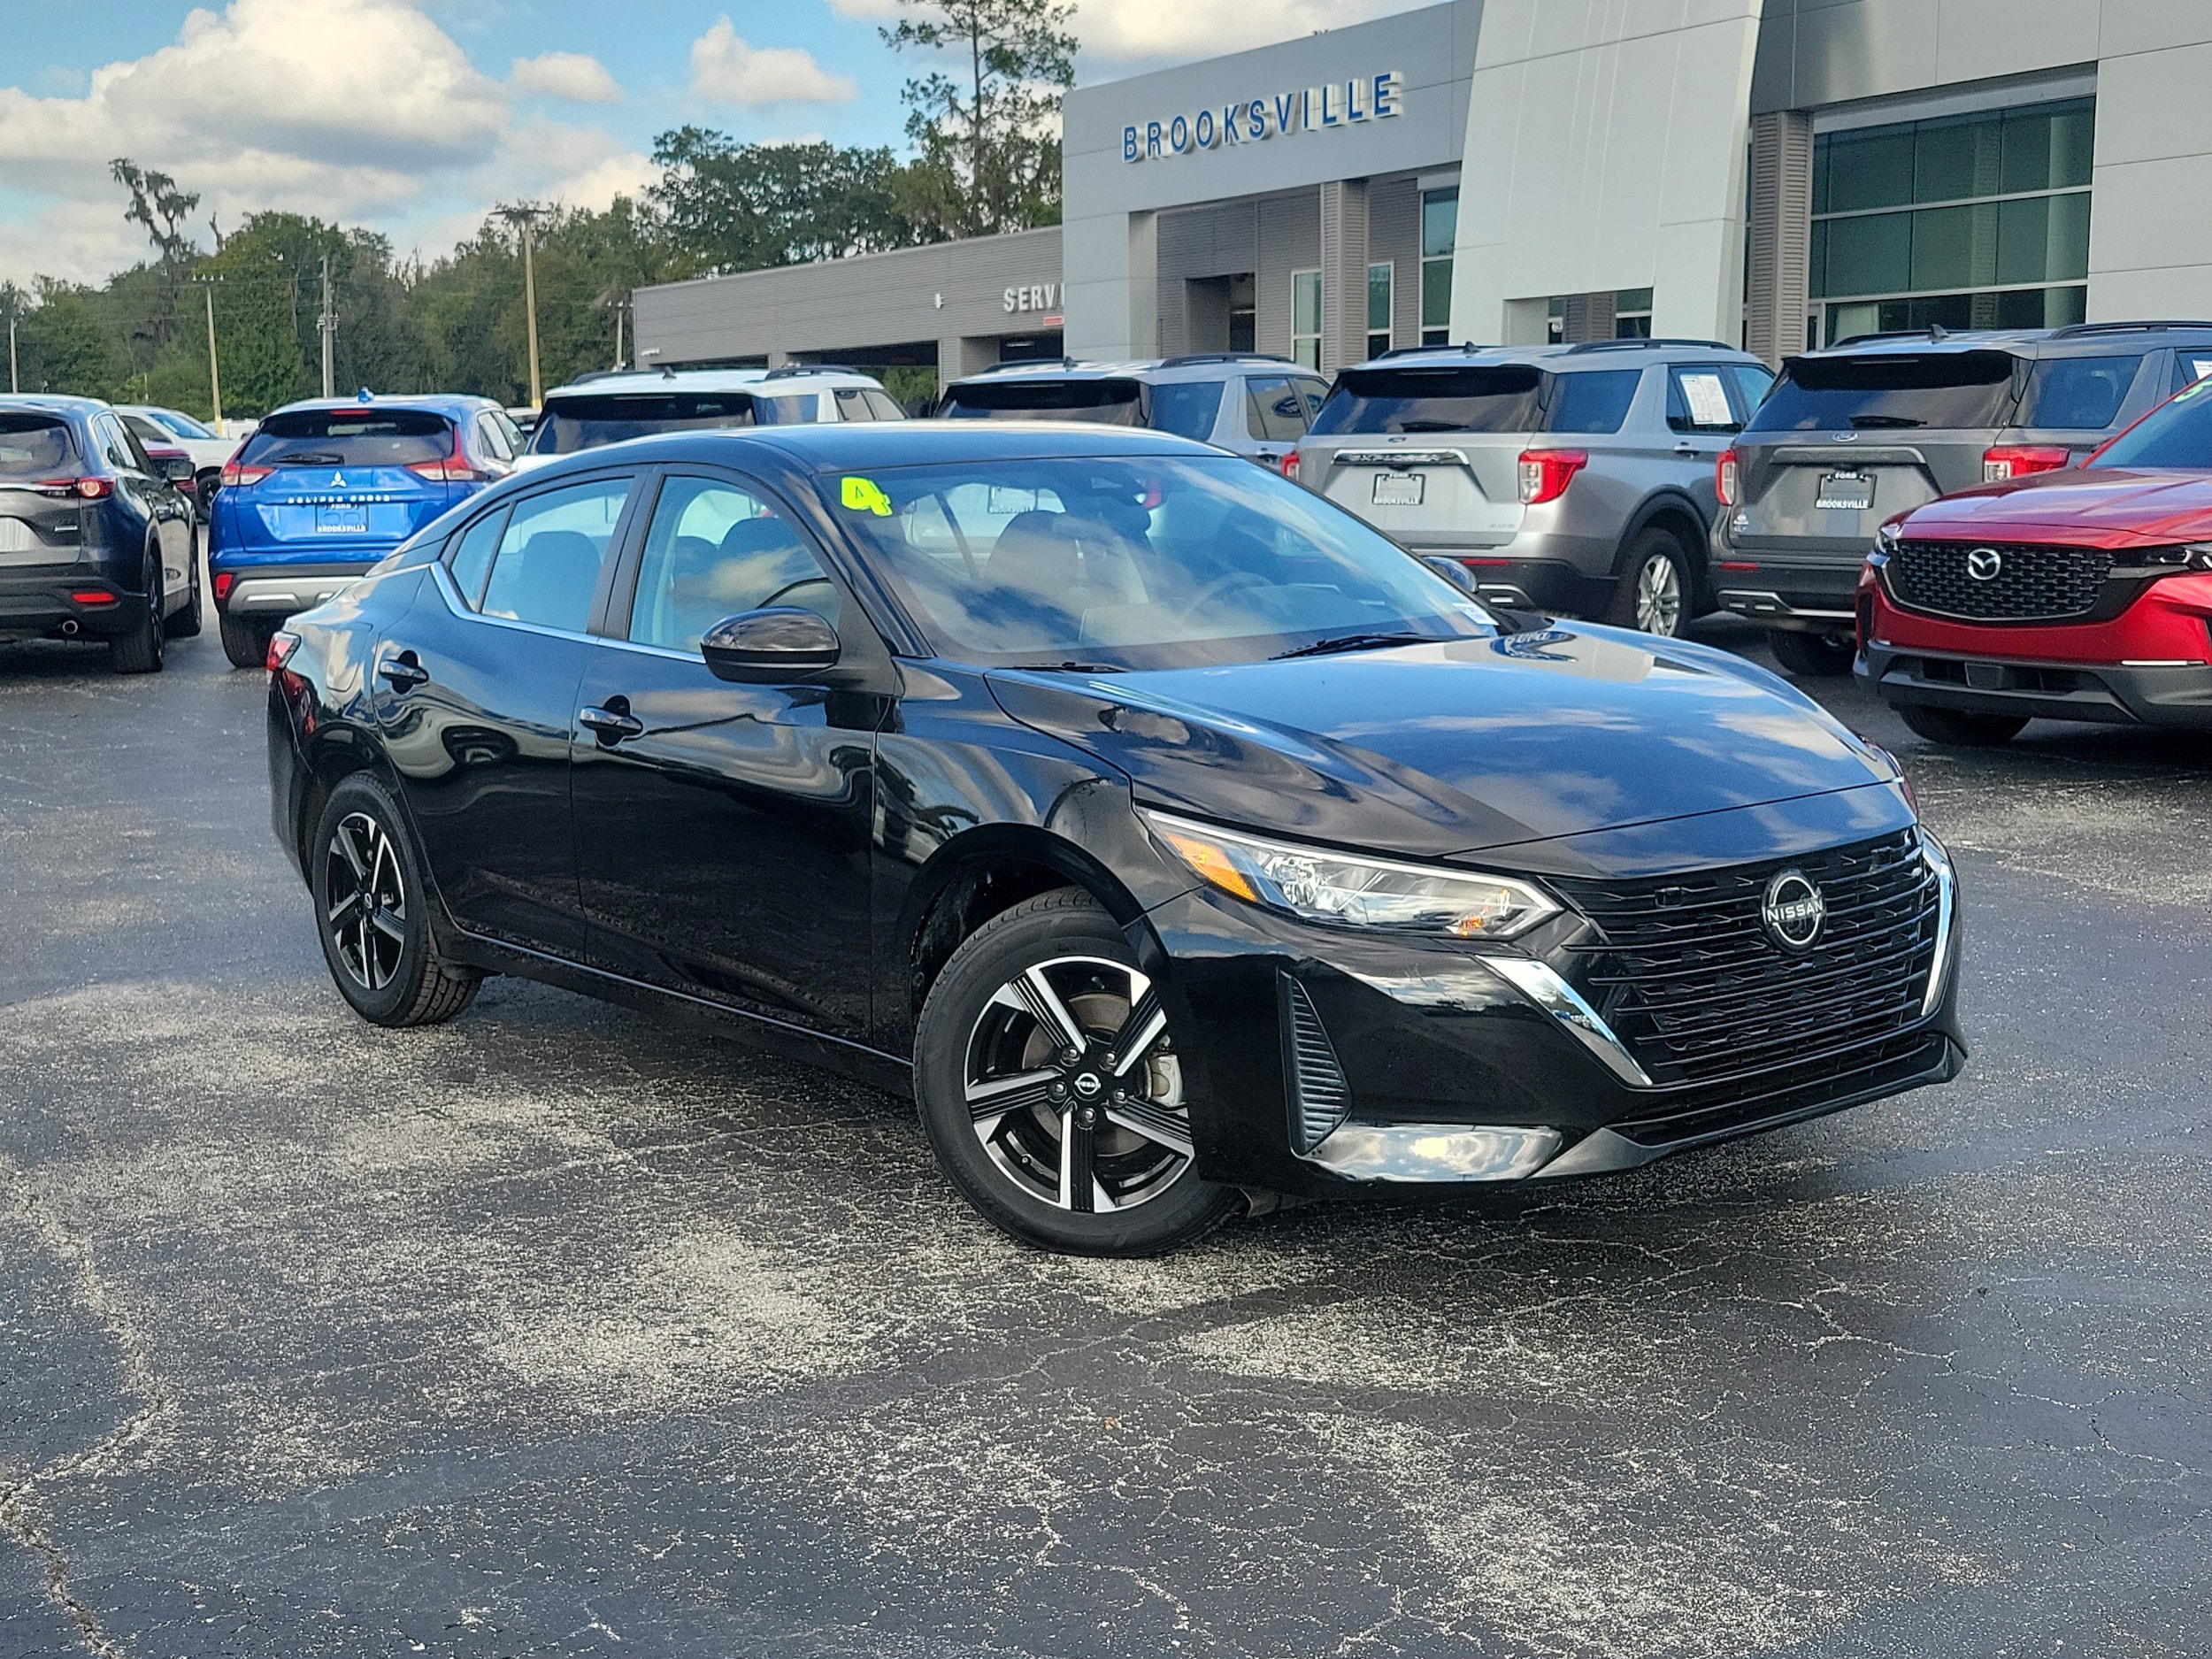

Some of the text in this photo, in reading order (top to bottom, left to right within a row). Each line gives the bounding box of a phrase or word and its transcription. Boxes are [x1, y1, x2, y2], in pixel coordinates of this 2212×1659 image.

[1122, 71, 1404, 163] BROOKSVILLE
[1816, 499, 1868, 509] BROOKSVILLE
[1767, 896, 1823, 922] NISSAN
